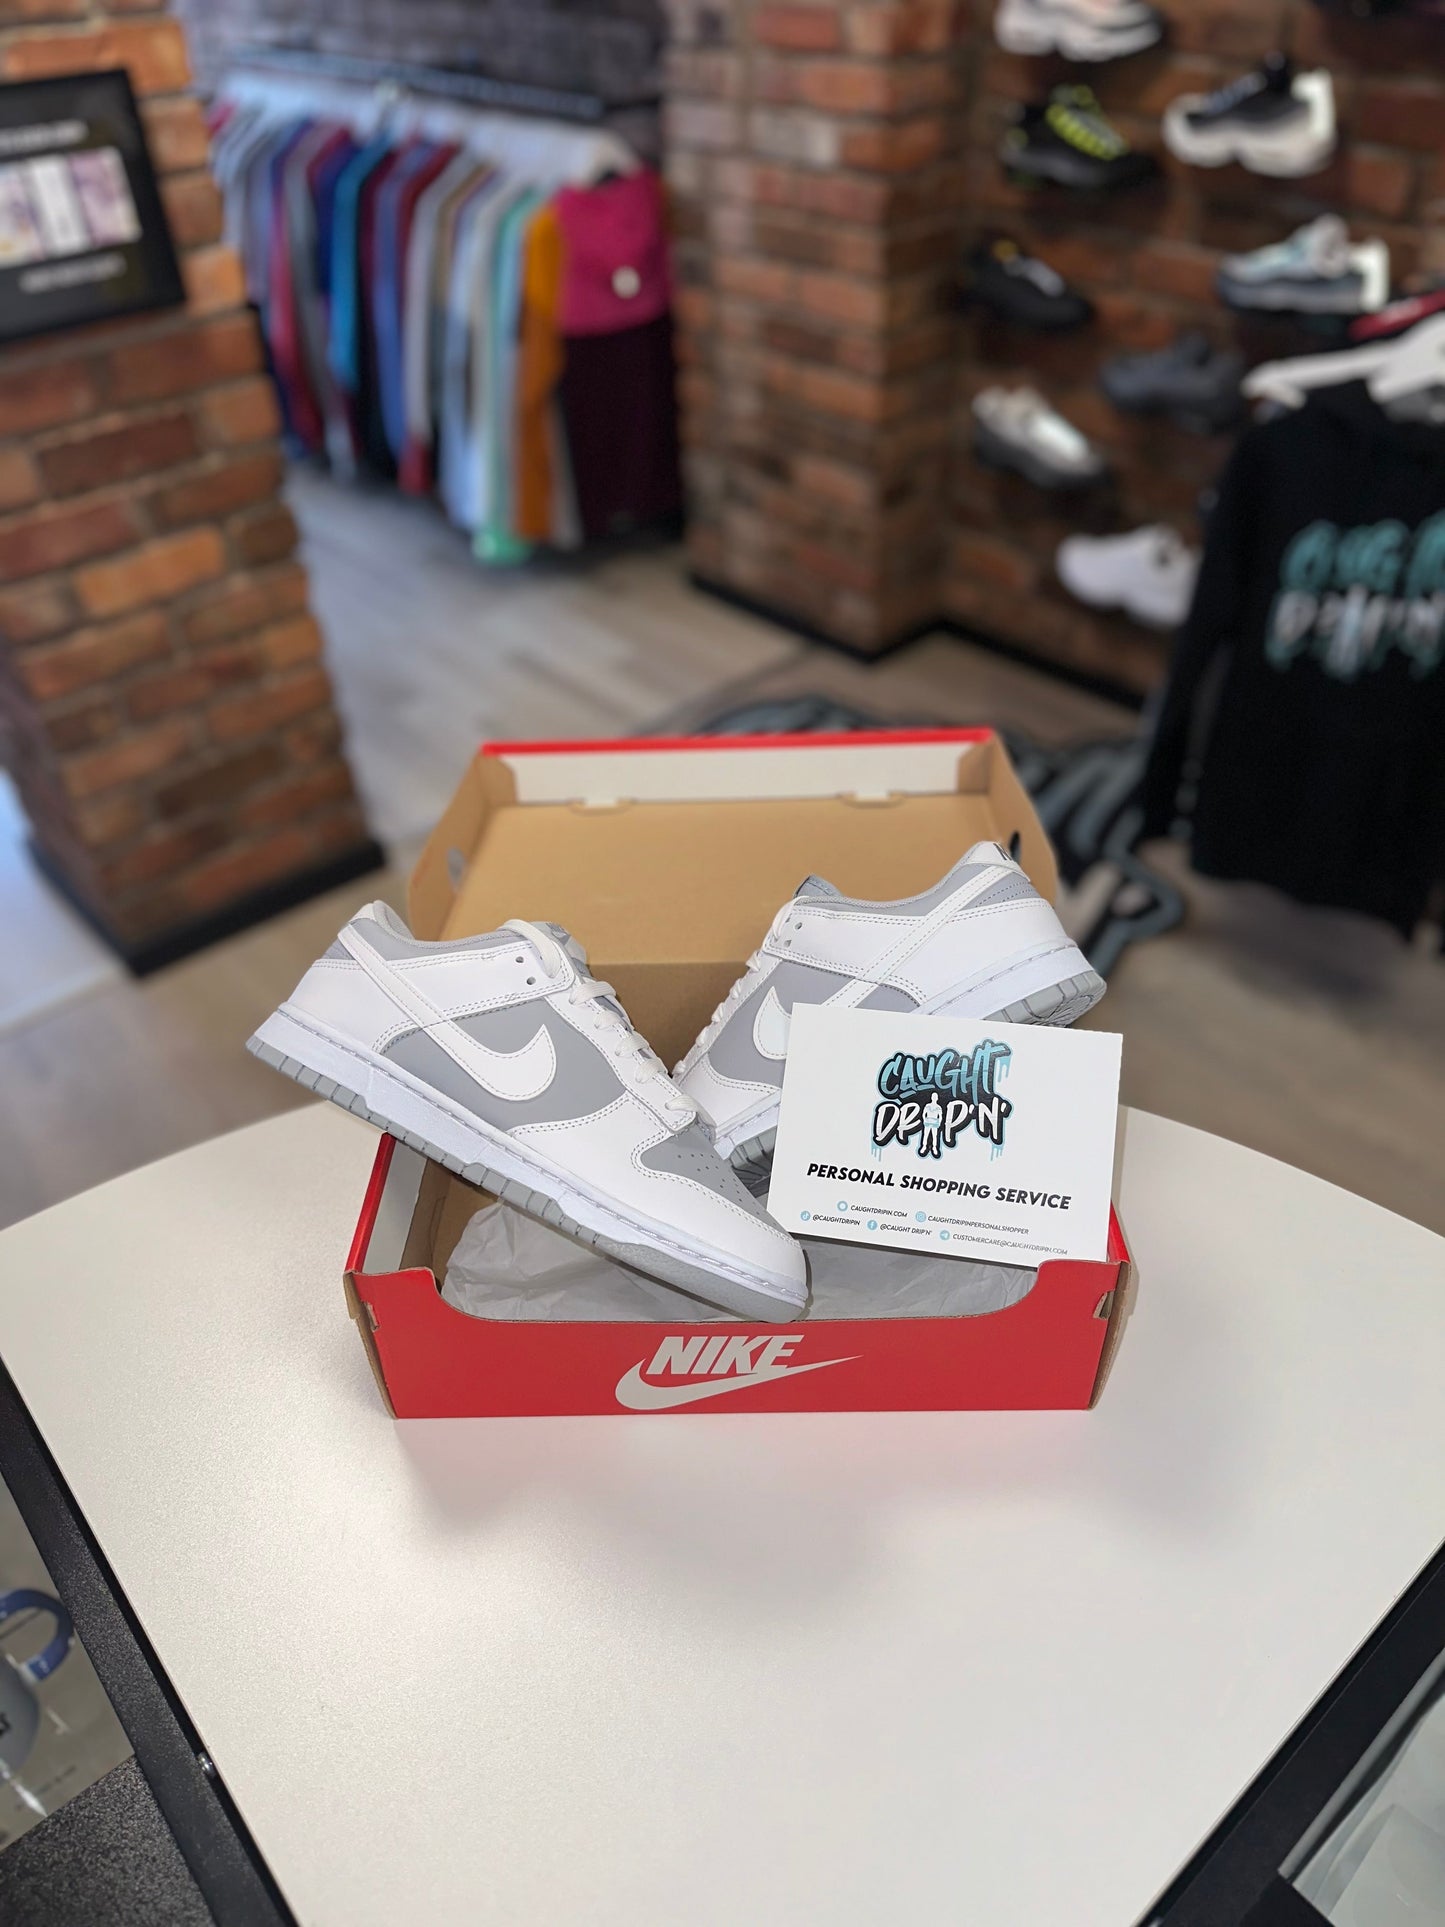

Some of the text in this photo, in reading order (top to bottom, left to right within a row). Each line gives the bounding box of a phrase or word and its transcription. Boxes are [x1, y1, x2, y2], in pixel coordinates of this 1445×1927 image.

[880, 1041, 1007, 1106] CAUGHT
[807, 1163, 1072, 1210] PERSONAL SHOPPING SERVICE
[812, 1214, 861, 1226] @CAUGHTDRIPIN
[850, 1204, 908, 1218] CAUGHTDRIPIN.COM
[879, 1223, 911, 1233] @CAUGHT
[646, 1334, 805, 1375] NIKE
